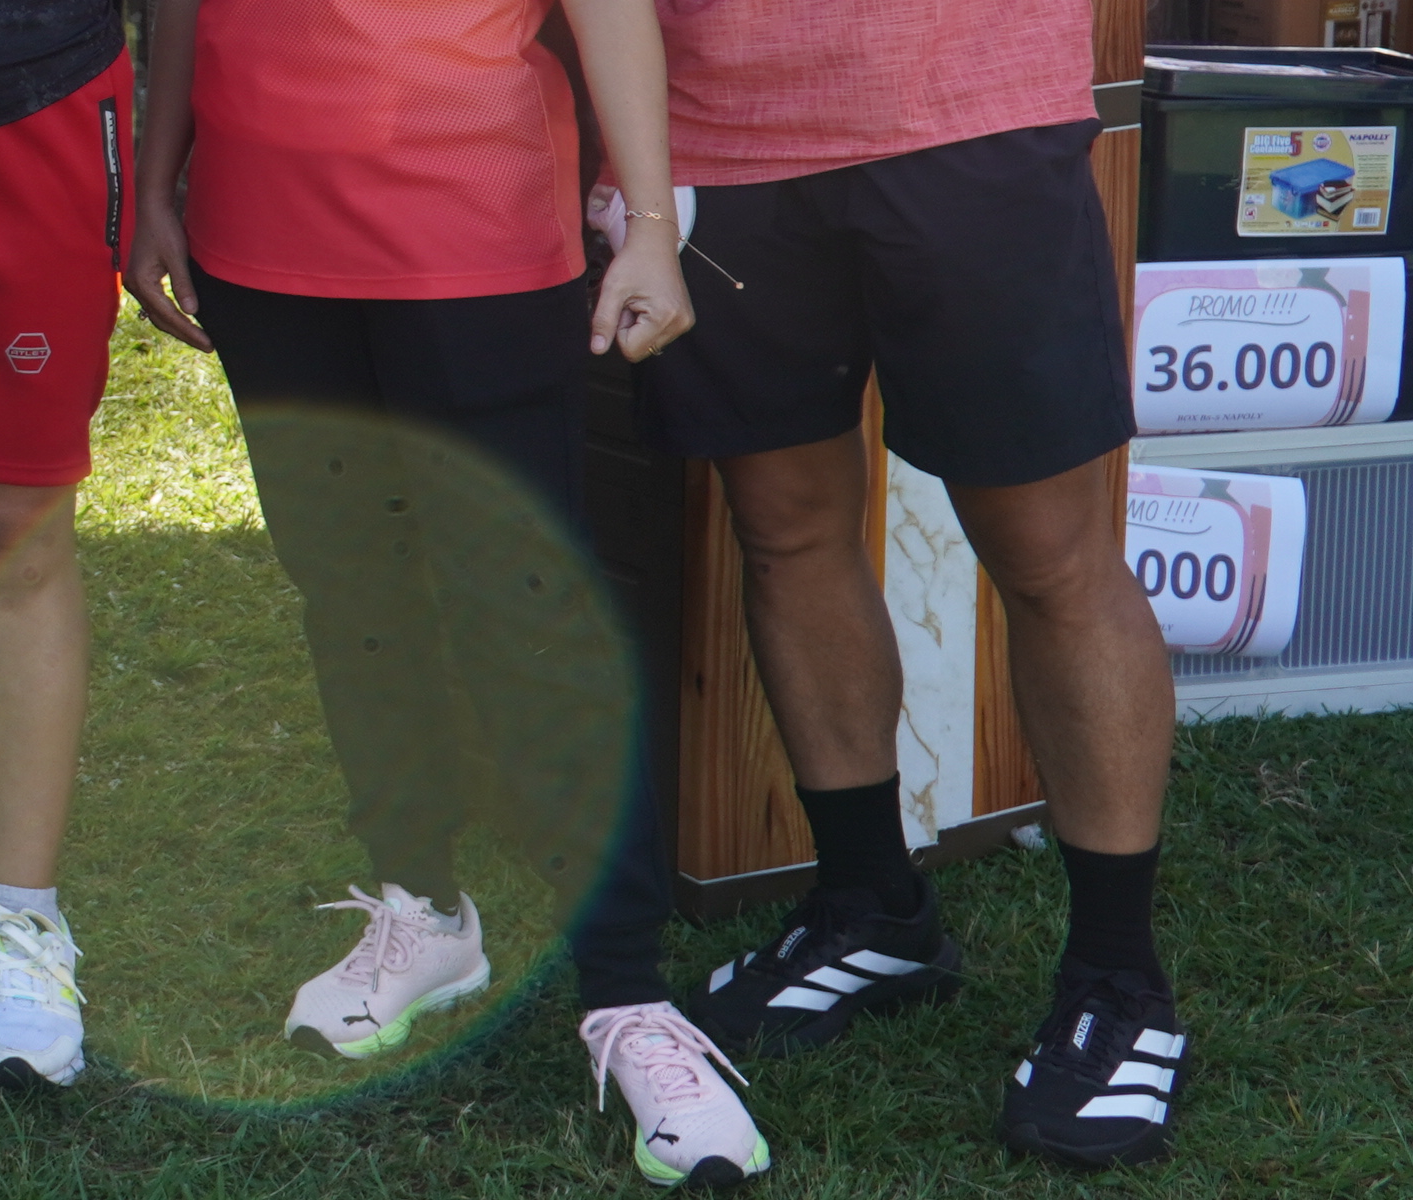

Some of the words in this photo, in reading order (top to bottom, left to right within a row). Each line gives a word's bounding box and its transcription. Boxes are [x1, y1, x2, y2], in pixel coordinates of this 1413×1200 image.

[1349, 133, 1390, 142] NAPOLLY
[1189, 293, 1256, 317] PROMO
[1145, 340, 1337, 394] 36.000
[1176, 414, 1199, 422] BOX
